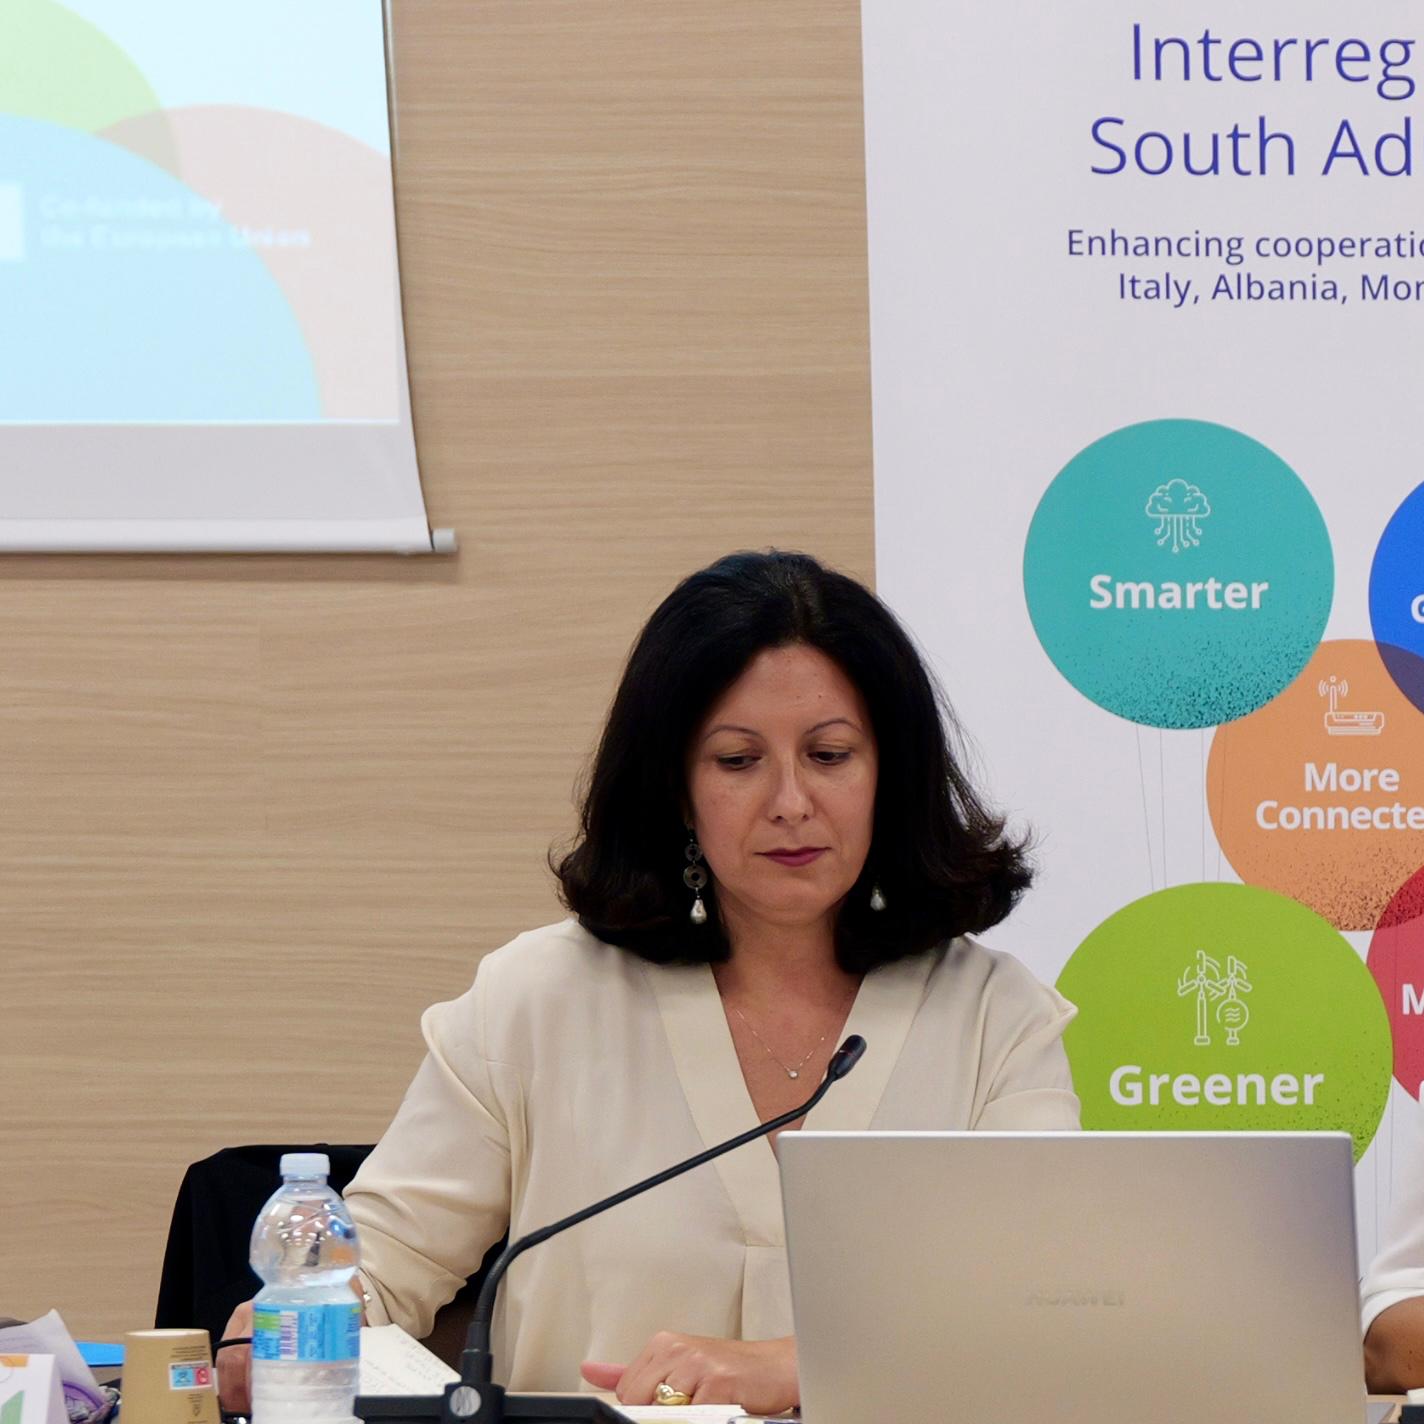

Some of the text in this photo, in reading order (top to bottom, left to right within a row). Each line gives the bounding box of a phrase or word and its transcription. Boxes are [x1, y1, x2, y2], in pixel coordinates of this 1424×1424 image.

[1132, 23, 1416, 101] Interreg
[1089, 115, 1296, 178] South
[1067, 228, 1244, 266] Enhancing
[1118, 272, 1200, 309] Italy,
[1211, 272, 1348, 306] Albania,
[1089, 574, 1269, 610] Smarter
[1304, 762, 1400, 793] More
[1109, 1064, 1325, 1106] Greener
